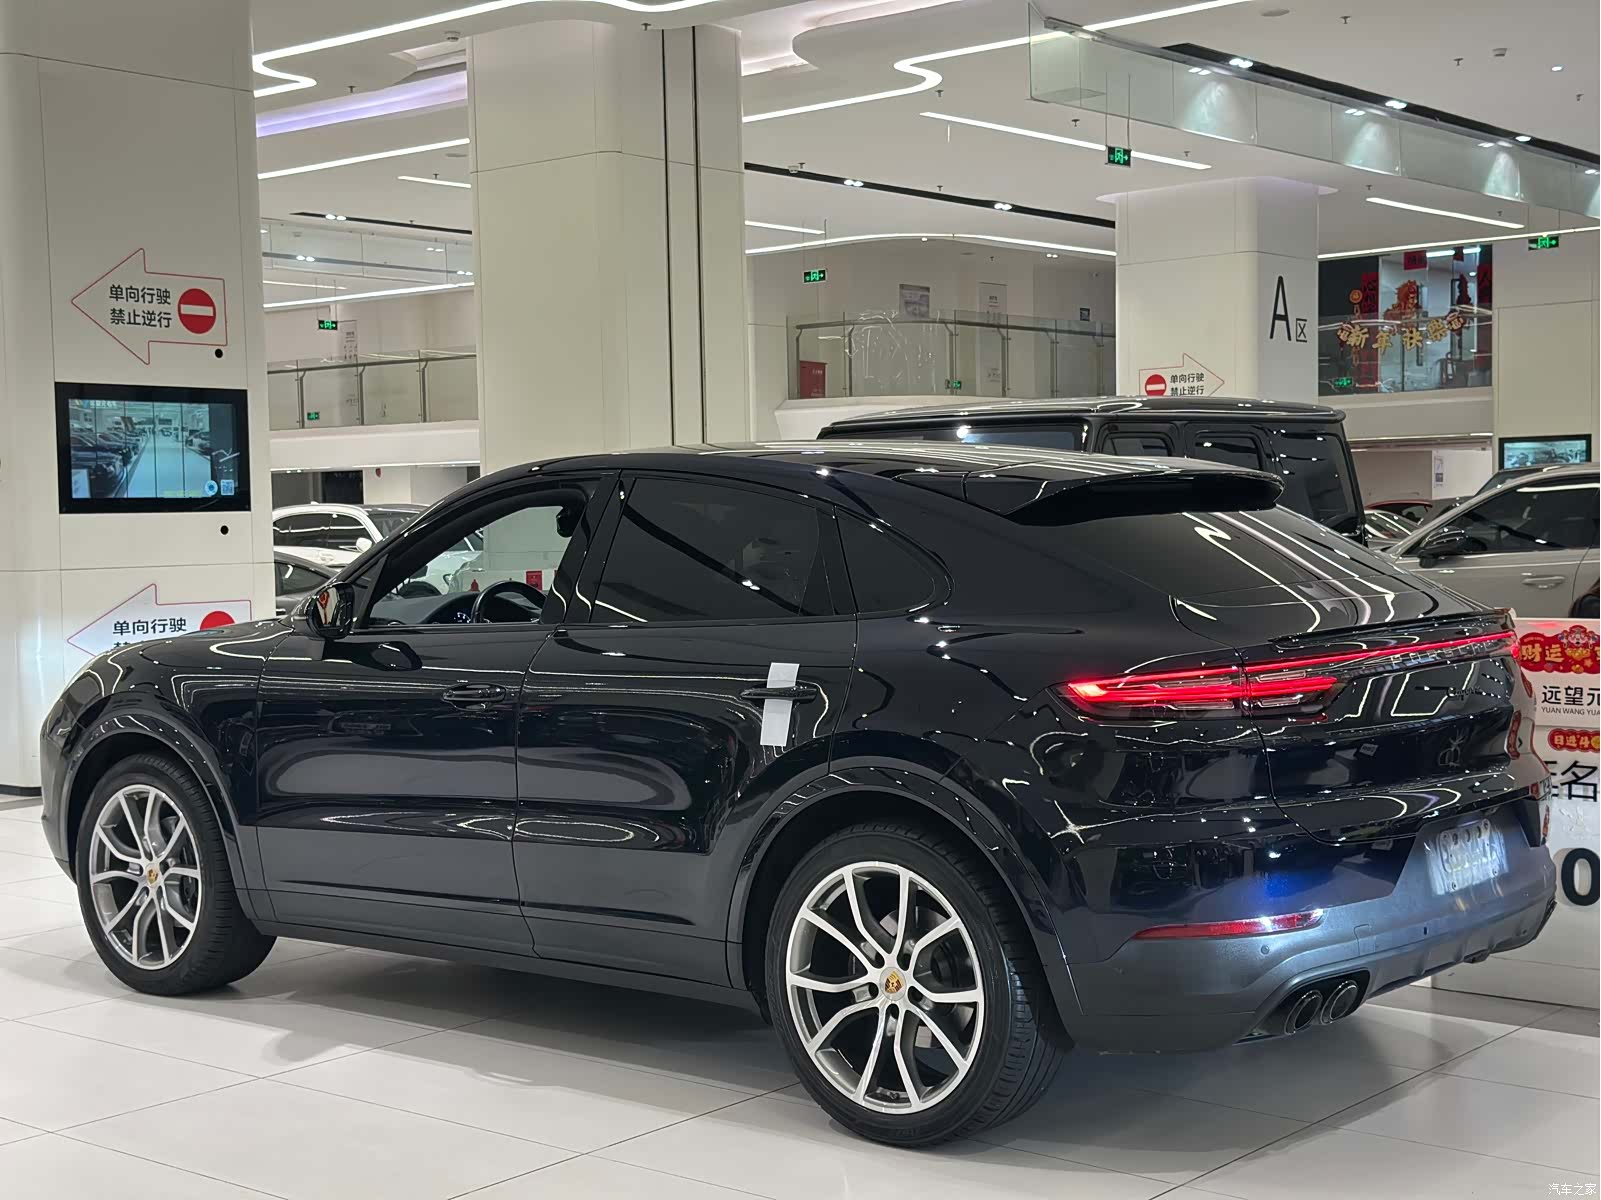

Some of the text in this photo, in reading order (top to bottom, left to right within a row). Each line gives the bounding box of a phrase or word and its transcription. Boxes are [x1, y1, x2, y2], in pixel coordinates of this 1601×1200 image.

[109, 284, 171, 305] 单向行驶
[110, 308, 172, 328] 禁止逆行
[1170, 373, 1205, 384] 单向行驶
[1170, 385, 1205, 397] 禁止逆行
[113, 618, 187, 636] 单向行驶
[1521, 643, 1565, 662] 财运
[1541, 685, 1600, 706] 远望元
[1541, 706, 1561, 714] YUAN
